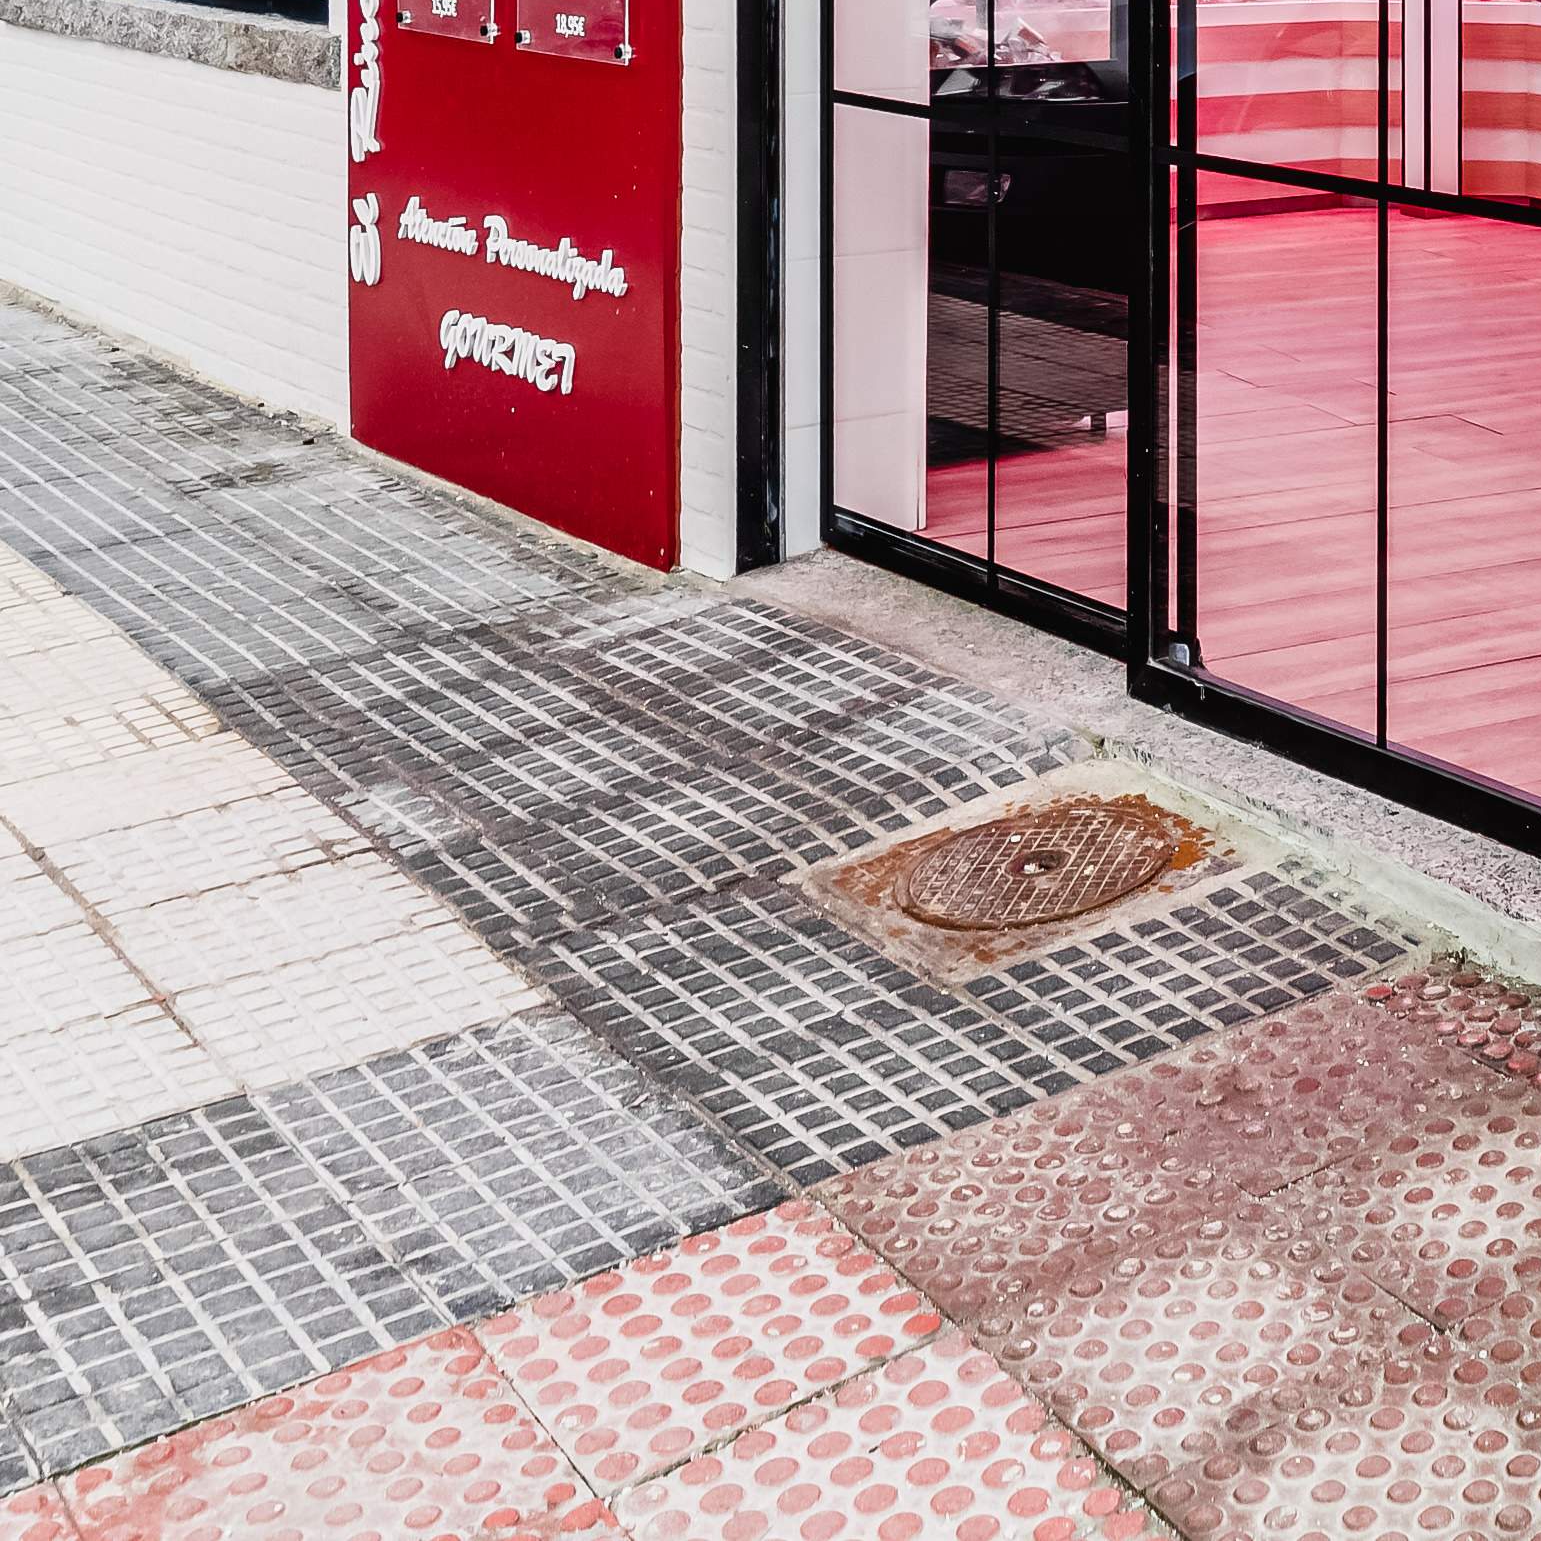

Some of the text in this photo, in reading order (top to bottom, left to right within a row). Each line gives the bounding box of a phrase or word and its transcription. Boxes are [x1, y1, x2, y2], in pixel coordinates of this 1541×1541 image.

[555, 13, 586, 38] 18,95€
[350, 191, 381, 286] El
[397, 195, 628, 300] Atención Personalizada
[440, 309, 576, 396] GOURMET
